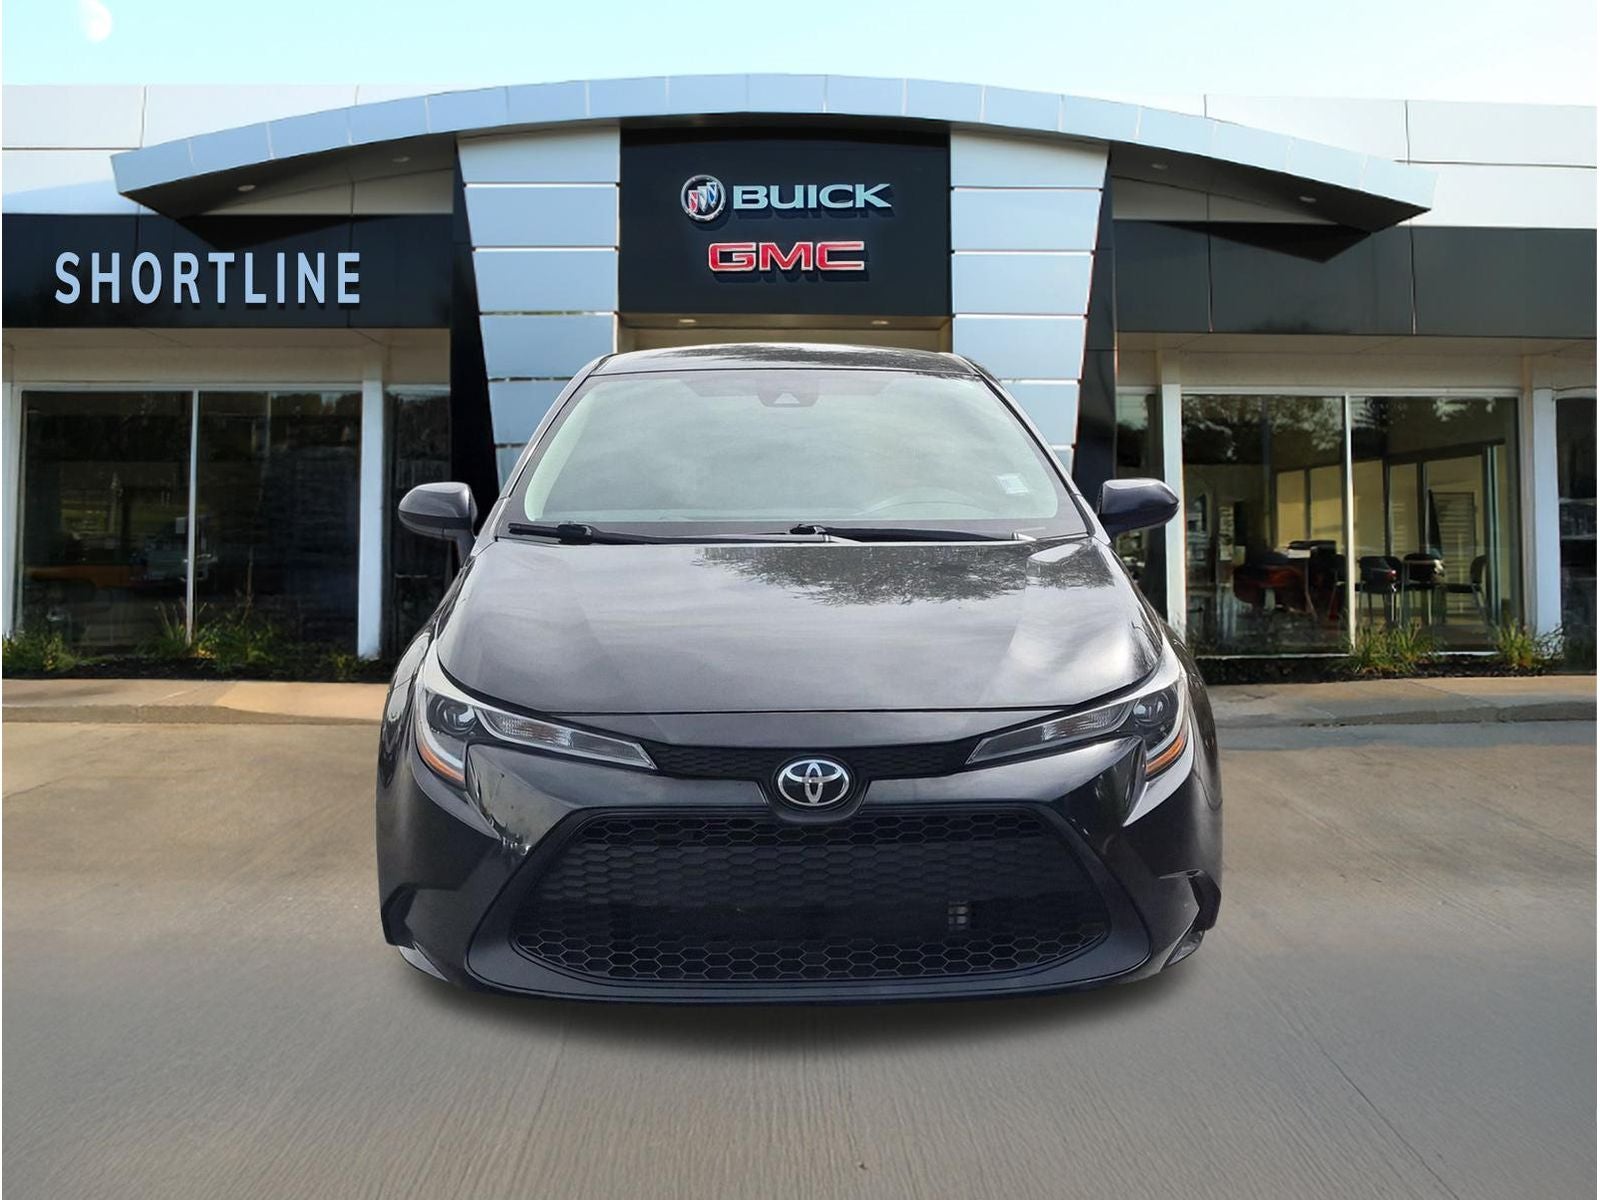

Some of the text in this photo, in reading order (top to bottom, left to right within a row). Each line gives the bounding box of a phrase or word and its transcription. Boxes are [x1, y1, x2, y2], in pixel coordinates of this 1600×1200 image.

[733, 183, 892, 210] BUICK
[708, 241, 865, 272] GMC
[55, 252, 361, 304] SHORTLINE
